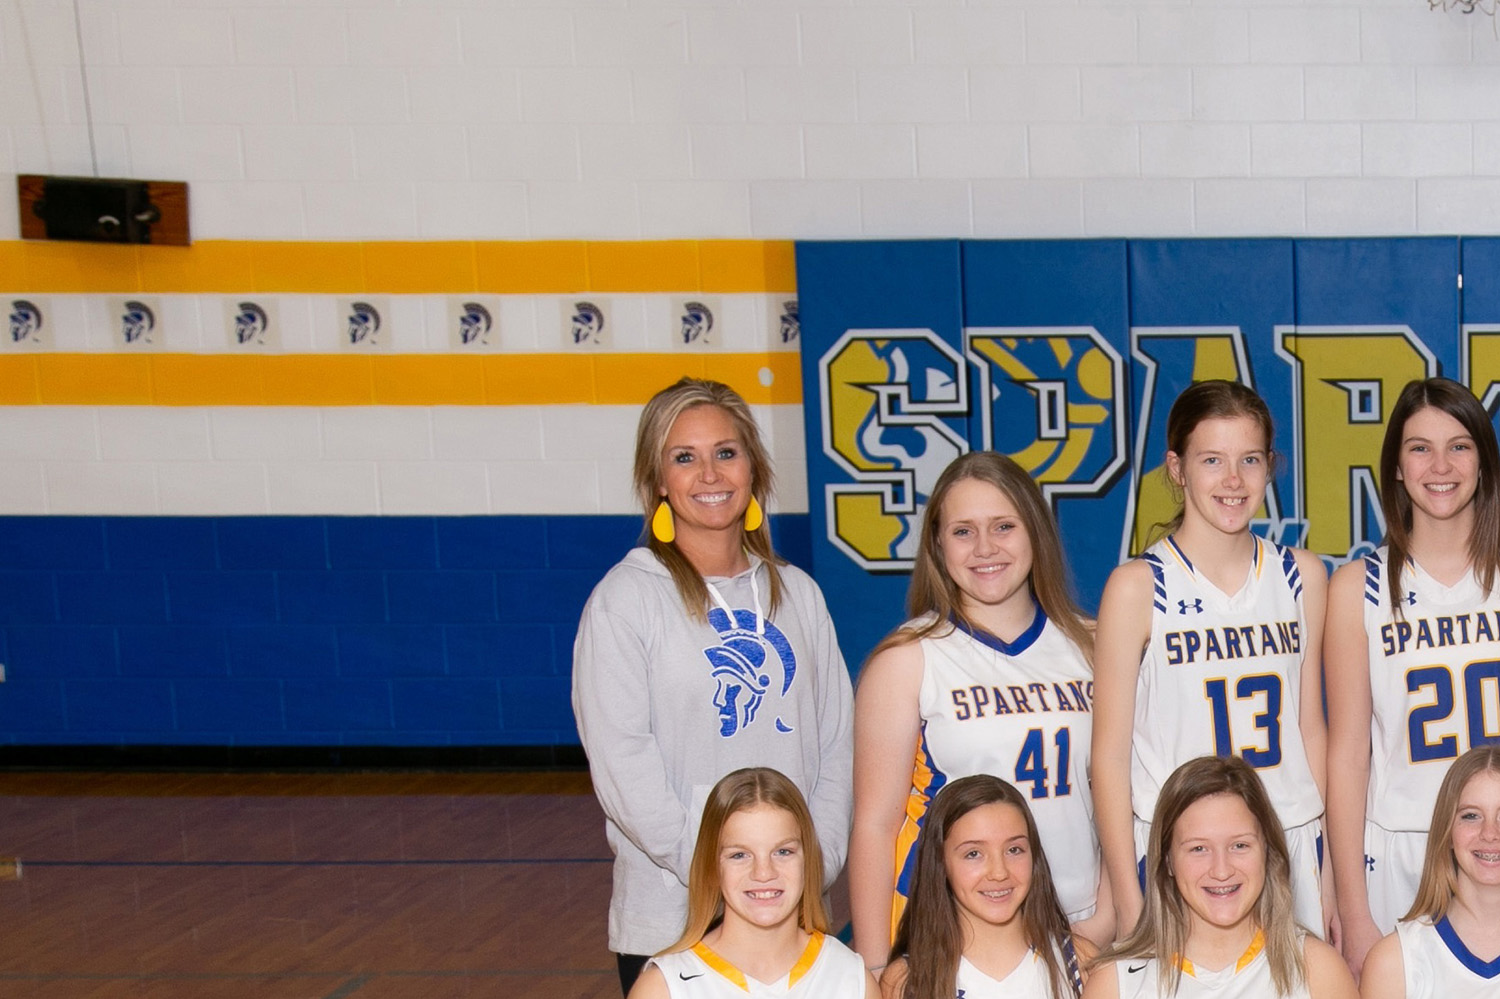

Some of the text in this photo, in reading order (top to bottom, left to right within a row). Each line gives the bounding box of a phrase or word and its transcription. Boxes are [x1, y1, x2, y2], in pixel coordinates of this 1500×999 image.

[1166, 621, 1300, 665] SPARTANS
[1203, 671, 1284, 770] 13
[1014, 726, 1072, 799] 41
